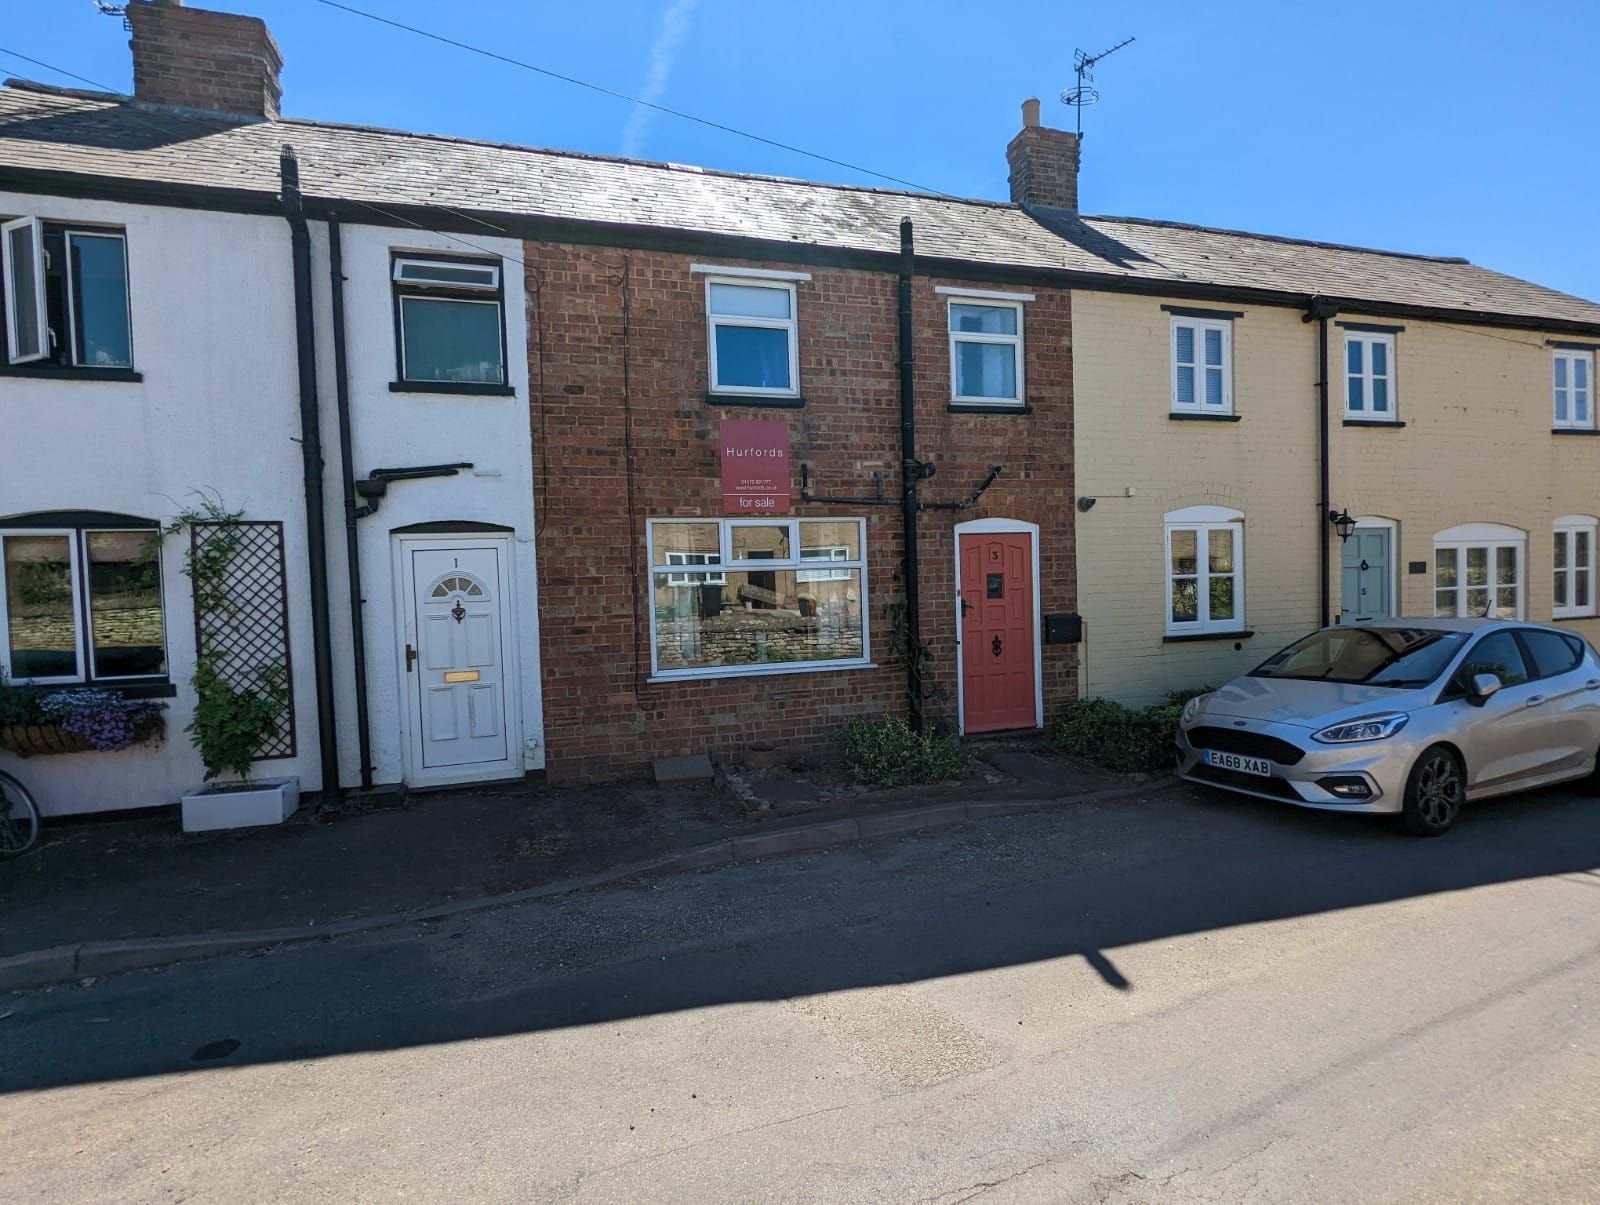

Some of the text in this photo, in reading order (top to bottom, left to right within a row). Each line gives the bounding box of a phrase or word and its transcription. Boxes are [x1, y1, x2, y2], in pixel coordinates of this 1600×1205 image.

[726, 447, 784, 458] Hurfords
[739, 497, 775, 508] for sale
[991, 551, 998, 560] 3
[453, 558, 458, 568] 1
[1361, 587, 1366, 595] 5
[1243, 758, 1269, 774] XAB
